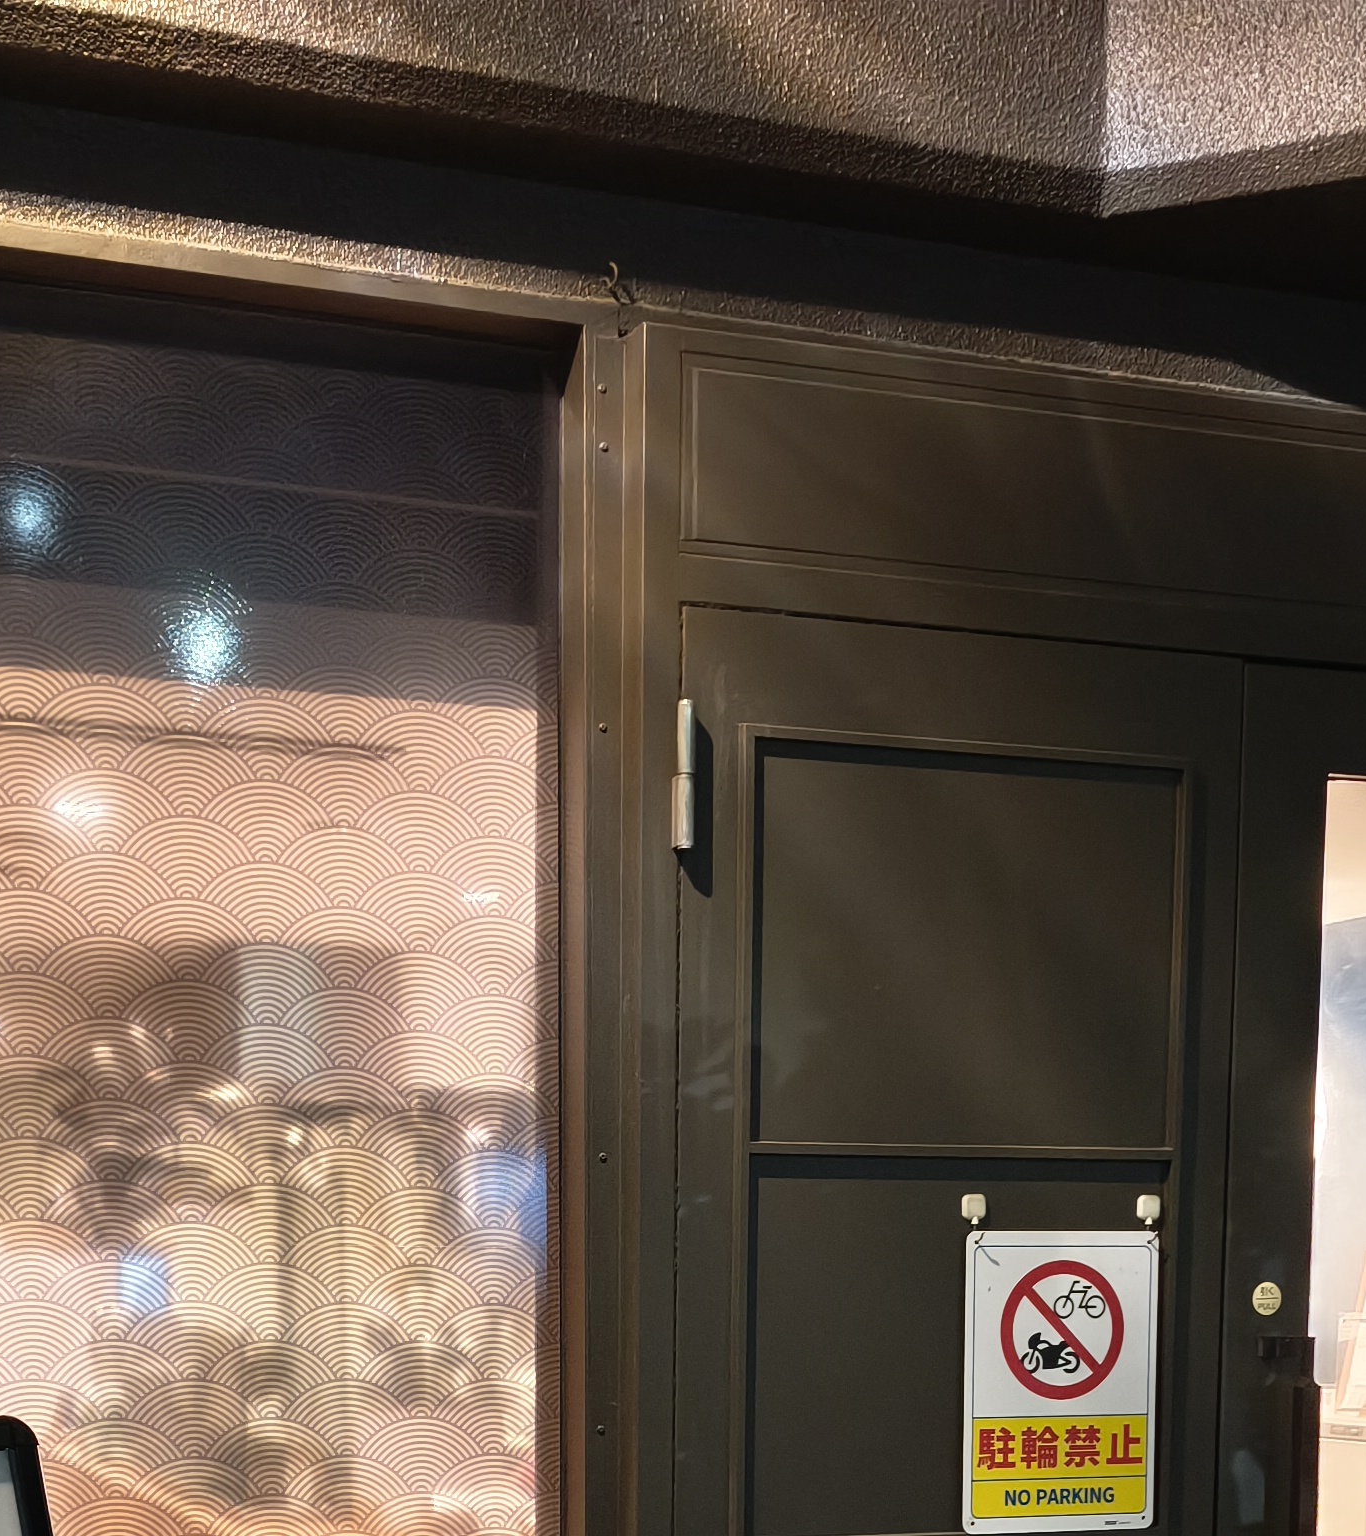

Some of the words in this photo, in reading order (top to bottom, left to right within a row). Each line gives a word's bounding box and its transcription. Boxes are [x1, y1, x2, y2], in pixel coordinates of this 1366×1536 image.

[977, 1424, 1144, 1470] 駐輪禁止
[1004, 1489, 1031, 1506] NO
[1036, 1486, 1115, 1505] PARKING
